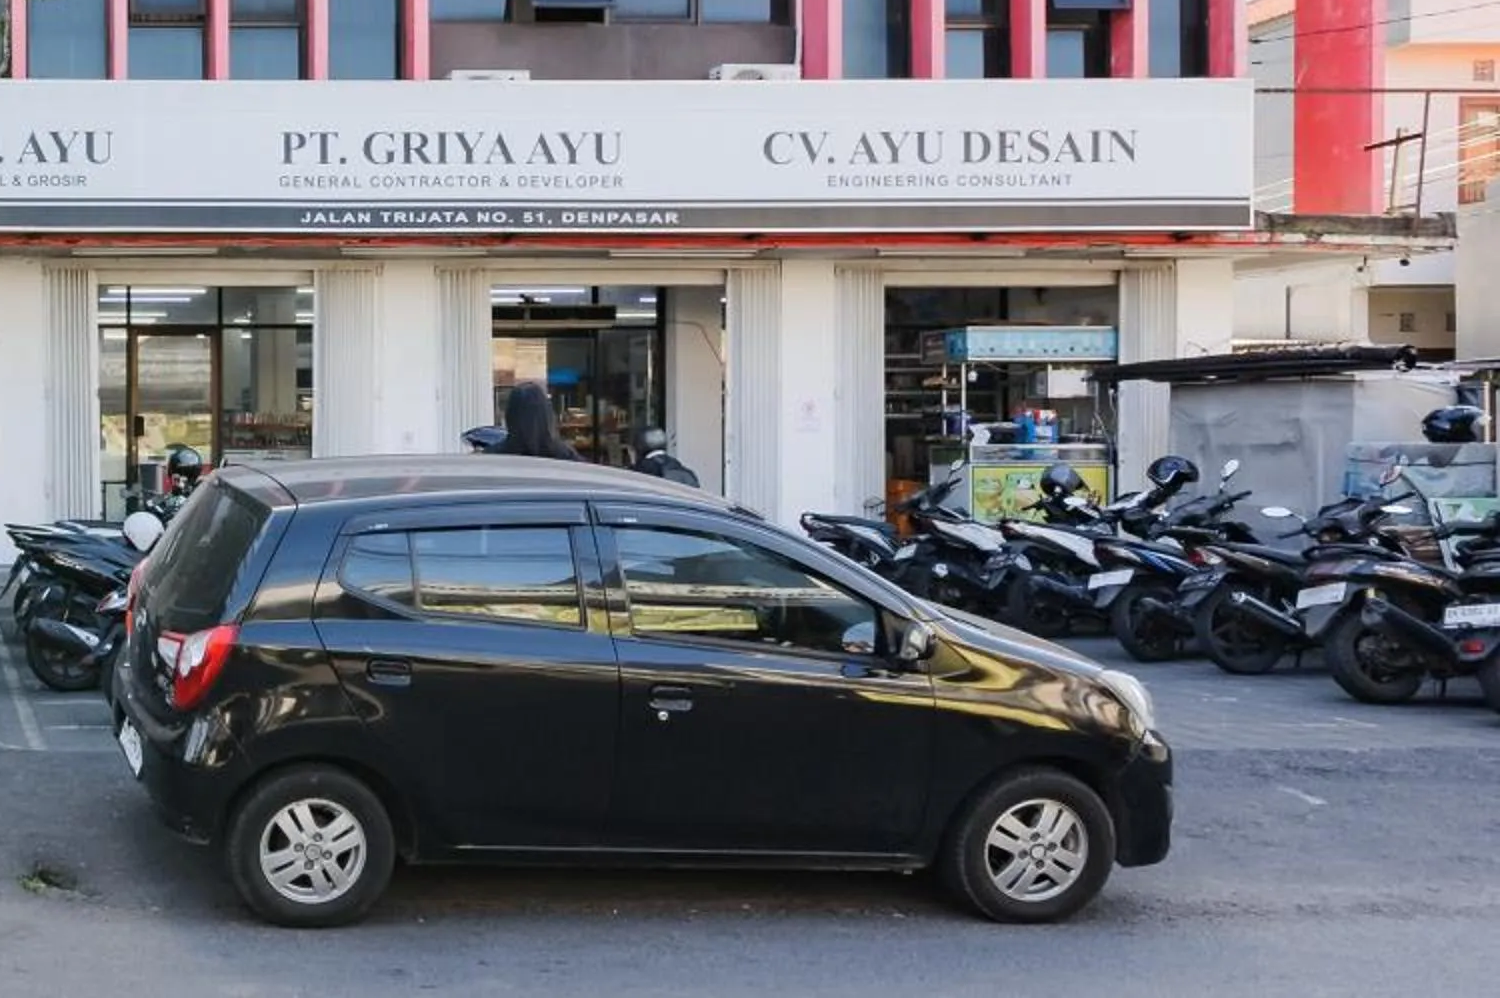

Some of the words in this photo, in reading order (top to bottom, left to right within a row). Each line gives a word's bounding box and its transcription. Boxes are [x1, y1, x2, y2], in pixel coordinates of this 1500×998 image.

[17, 129, 114, 165] AYU
[281, 131, 347, 165] PT.
[362, 131, 516, 165] GRIYA
[525, 131, 622, 165] AYU
[763, 130, 835, 165] CV.
[848, 130, 944, 165] AYU
[961, 129, 1139, 164] DESAIN
[11, 174, 22, 187] &
[27, 174, 88, 187] GROSIR
[279, 175, 362, 188] GENERAL
[369, 175, 492, 188] CONTRACTOR
[499, 175, 509, 188] &
[517, 175, 623, 188] DEVELOPER
[827, 175, 949, 187] ENGINEERING
[956, 174, 1073, 187] CONSULTANT
[301, 211, 371, 223] JALAN
[380, 211, 469, 223] TRIJATA
[477, 211, 514, 223] NO.
[561, 211, 680, 223] DENPASAR
